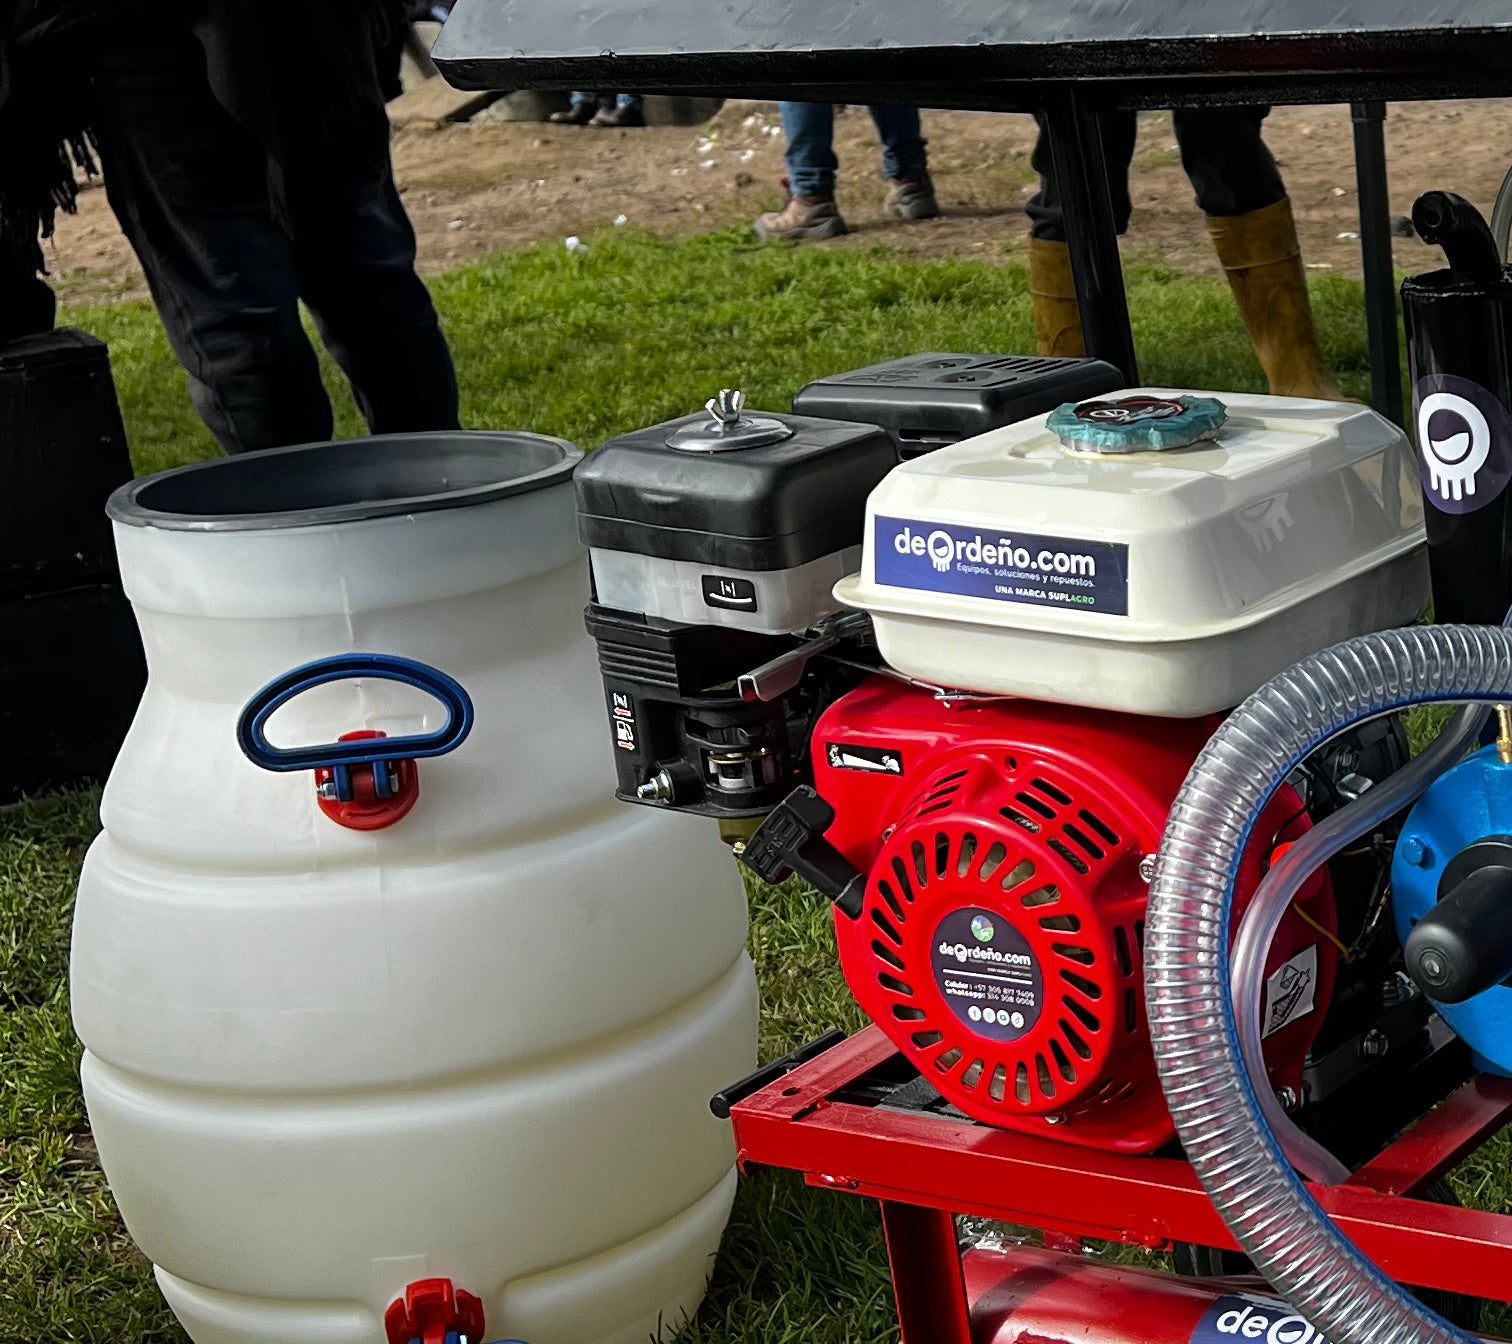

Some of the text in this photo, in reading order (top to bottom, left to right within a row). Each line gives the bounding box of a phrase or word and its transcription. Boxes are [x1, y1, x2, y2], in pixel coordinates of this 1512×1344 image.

[893, 525, 1097, 578] deOrdeño.com
[994, 568, 1041, 582] soluciones
[1049, 574, 1097, 589] repuestos.
[995, 584, 1096, 606] UNA MARCA SUPLAGRO
